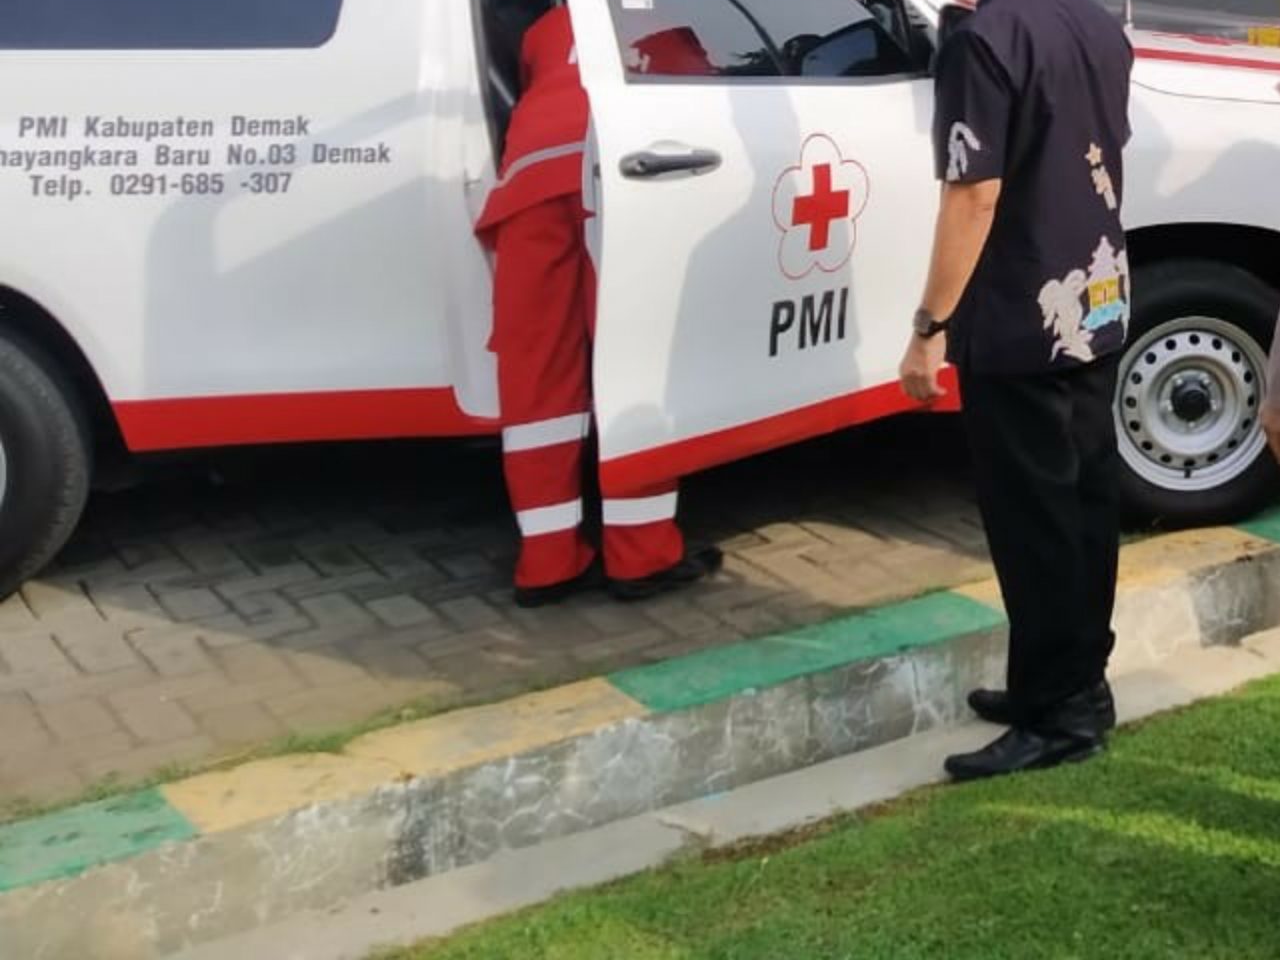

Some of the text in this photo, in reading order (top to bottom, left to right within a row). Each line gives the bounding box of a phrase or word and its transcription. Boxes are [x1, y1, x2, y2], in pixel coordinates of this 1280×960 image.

[19, 115, 311, 142] PMI Kabupaten Demak
[155, 144, 210, 167] Baru
[227, 143, 297, 167] No.03
[312, 143, 391, 166] Demak
[30, 172, 293, 200] Telp. 0291-685 -307
[769, 287, 850, 358] PMI
